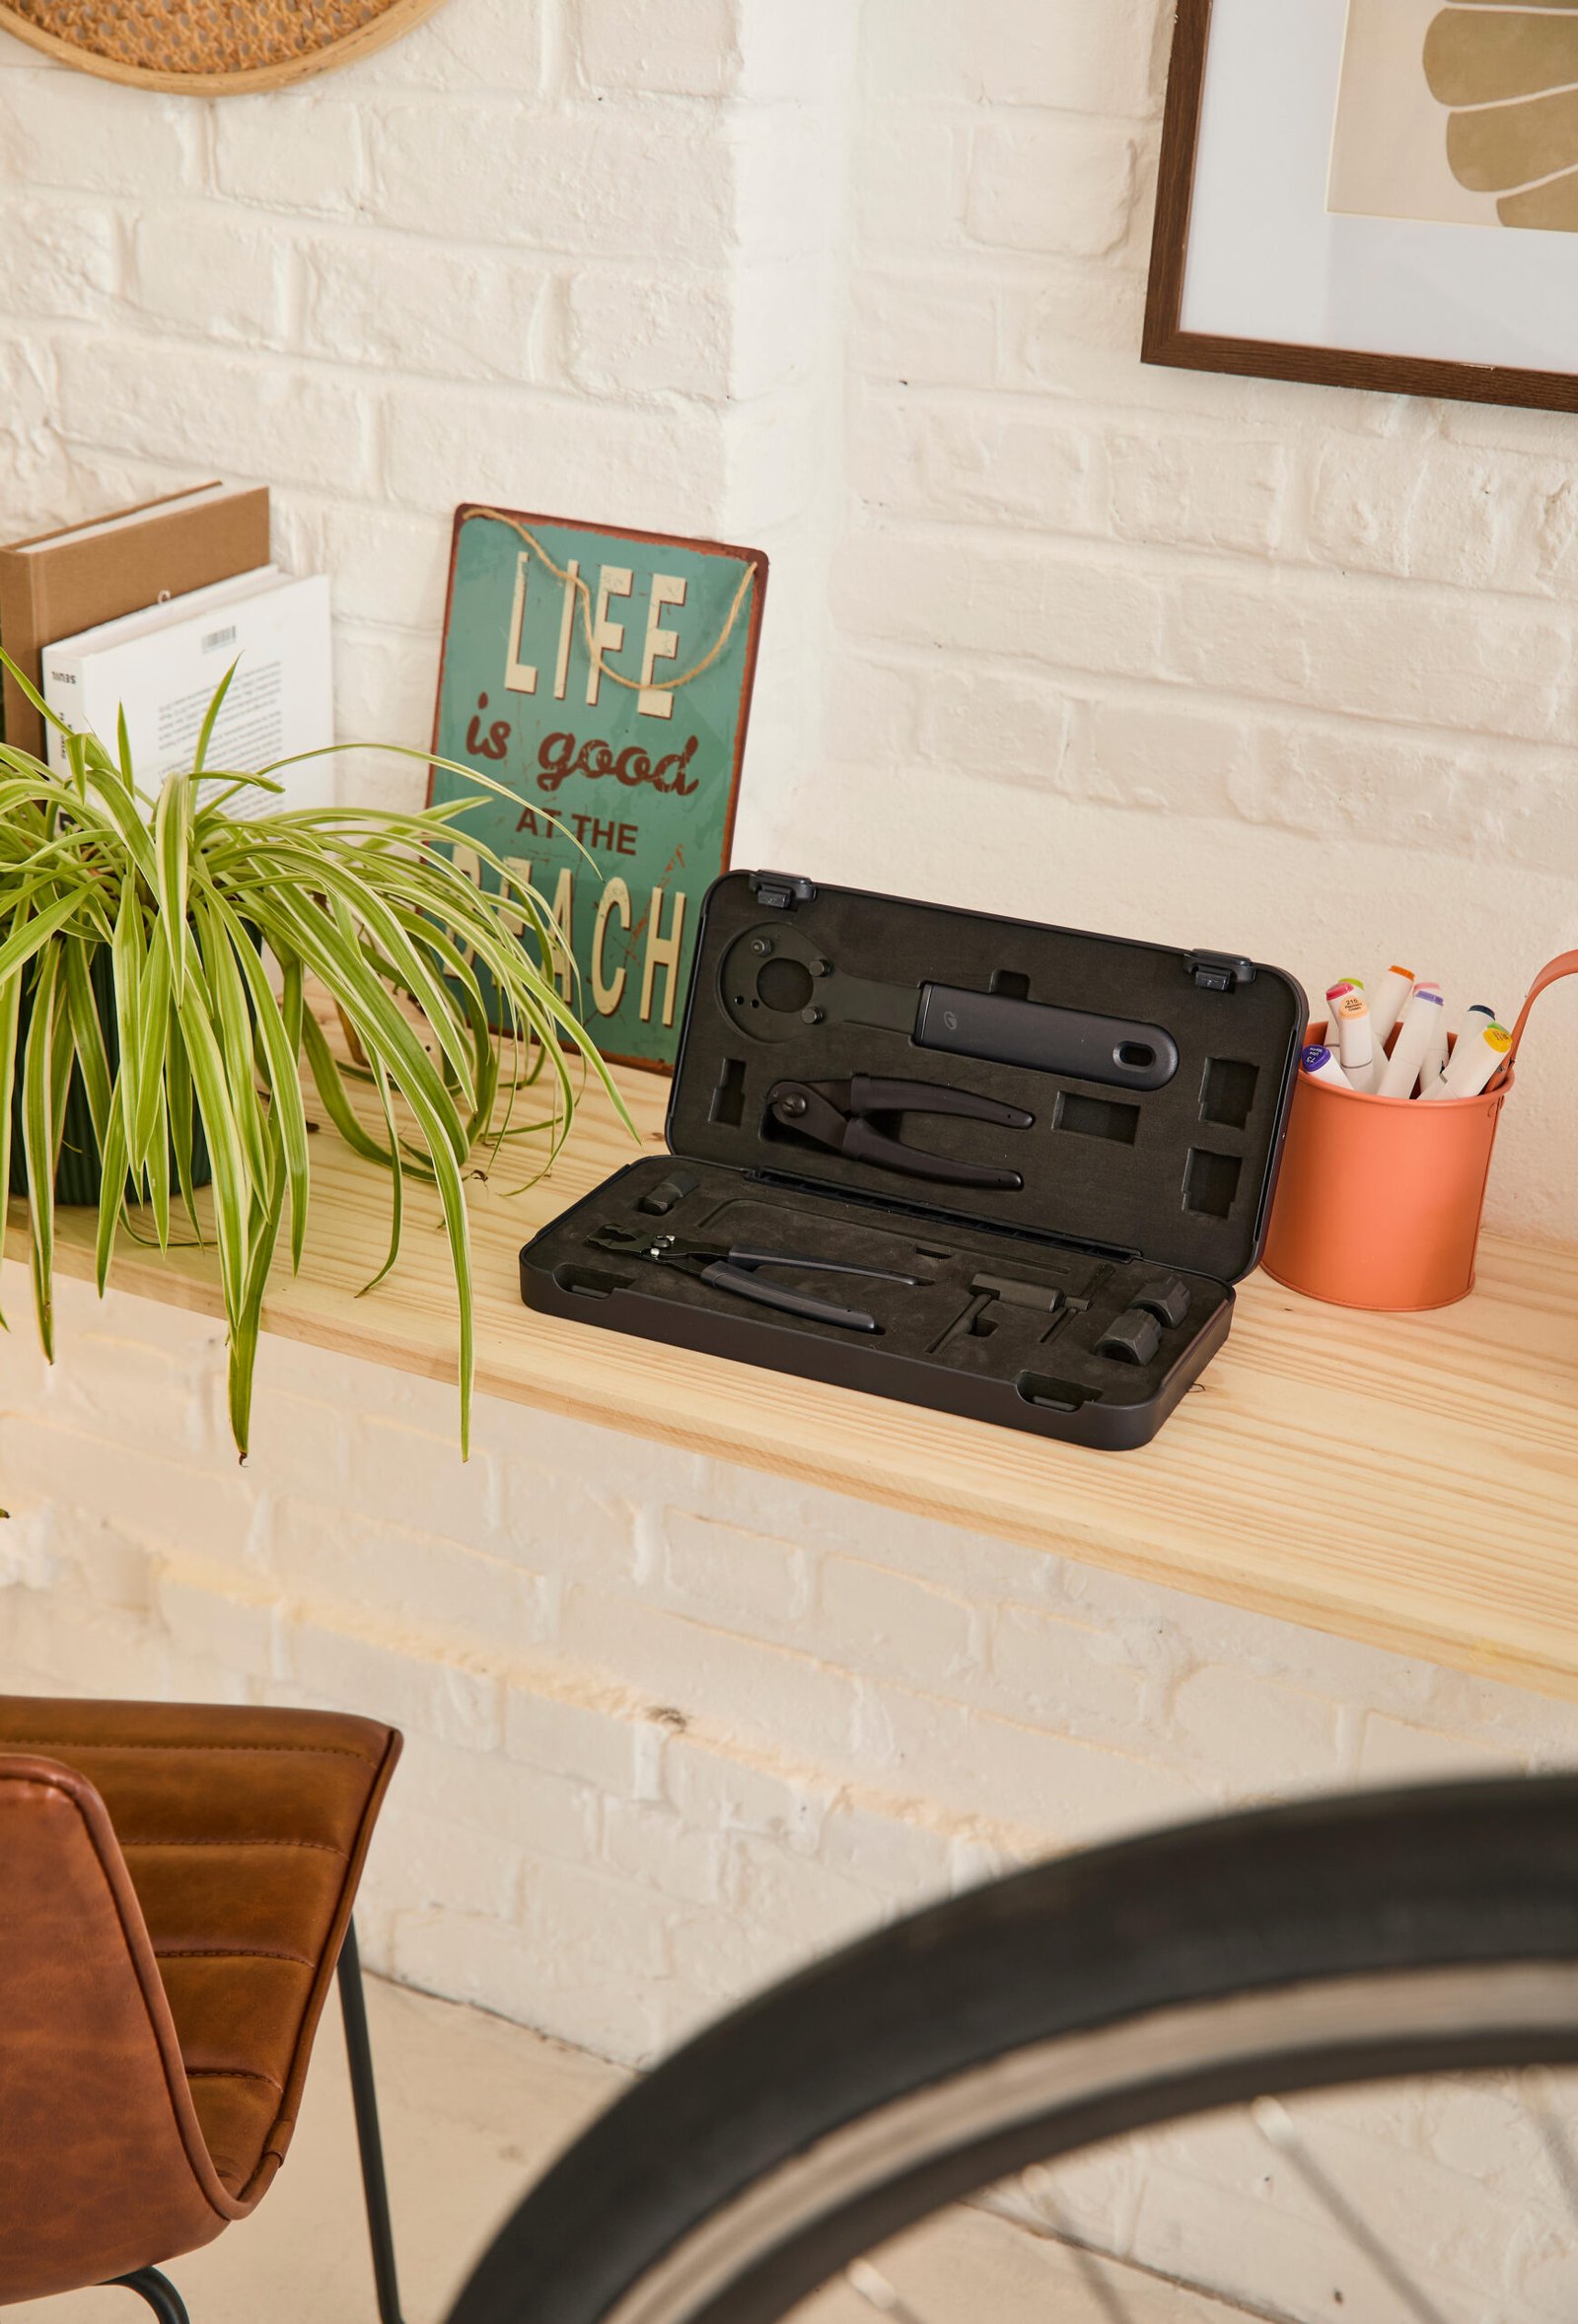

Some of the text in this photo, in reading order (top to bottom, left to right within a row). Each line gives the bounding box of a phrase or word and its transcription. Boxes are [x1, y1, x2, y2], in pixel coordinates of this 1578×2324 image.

[503, 550, 686, 719] LIFE
[466, 692, 699, 796] is good
[515, 807, 638, 856] AT THE
